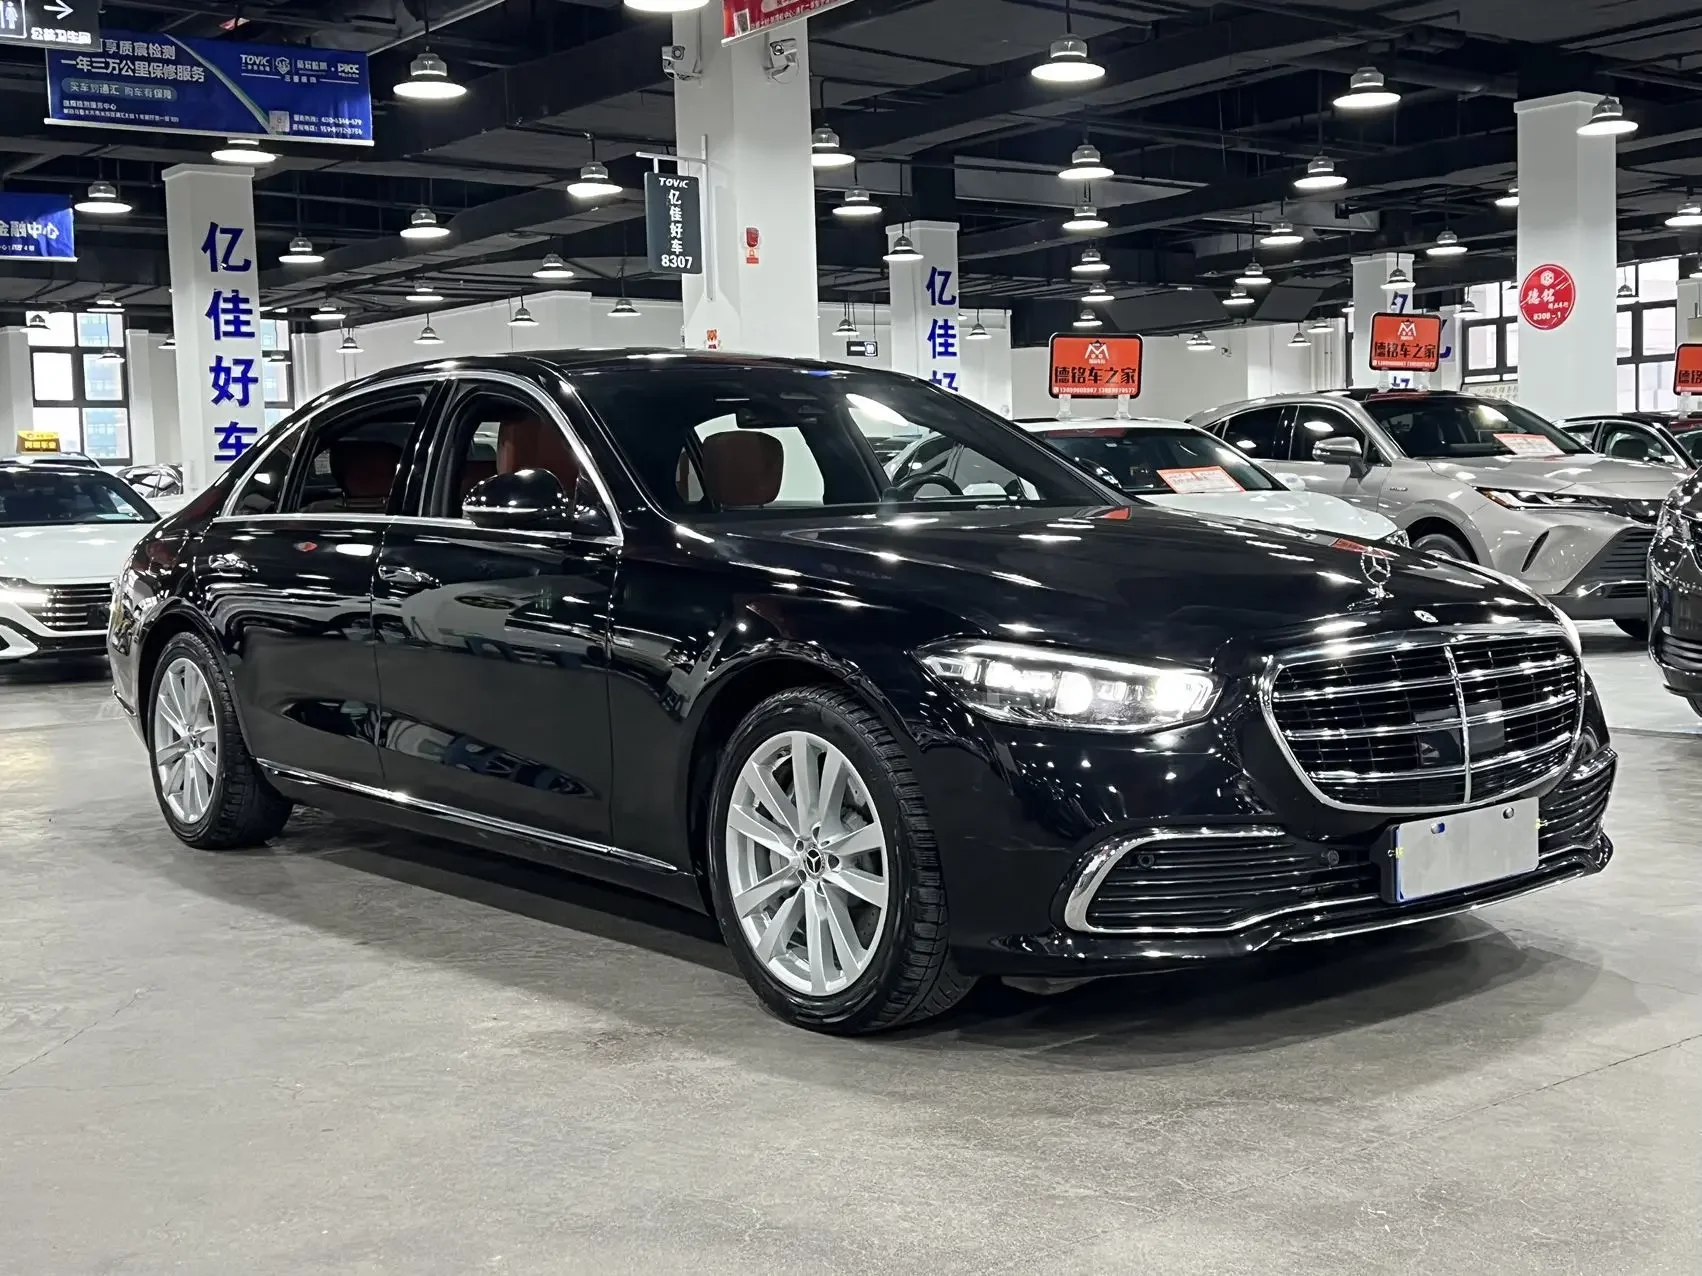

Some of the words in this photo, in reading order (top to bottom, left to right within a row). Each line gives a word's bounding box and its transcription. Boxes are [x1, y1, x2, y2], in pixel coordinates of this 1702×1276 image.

[60, 55, 205, 82] 一年三万公里保修服务
[240, 54, 270, 66] TOVIC
[658, 177, 689, 188] TOVIC
[0, 220, 60, 240] 金融中心
[668, 189, 683, 255] 亿佳好车
[661, 254, 692, 269] 8307
[1527, 288, 1555, 305] 德铭
[201, 221, 259, 462] 亿佳好车
[1374, 341, 1436, 359] 德铭车之家
[1054, 366, 1136, 385] 德铭车之家
